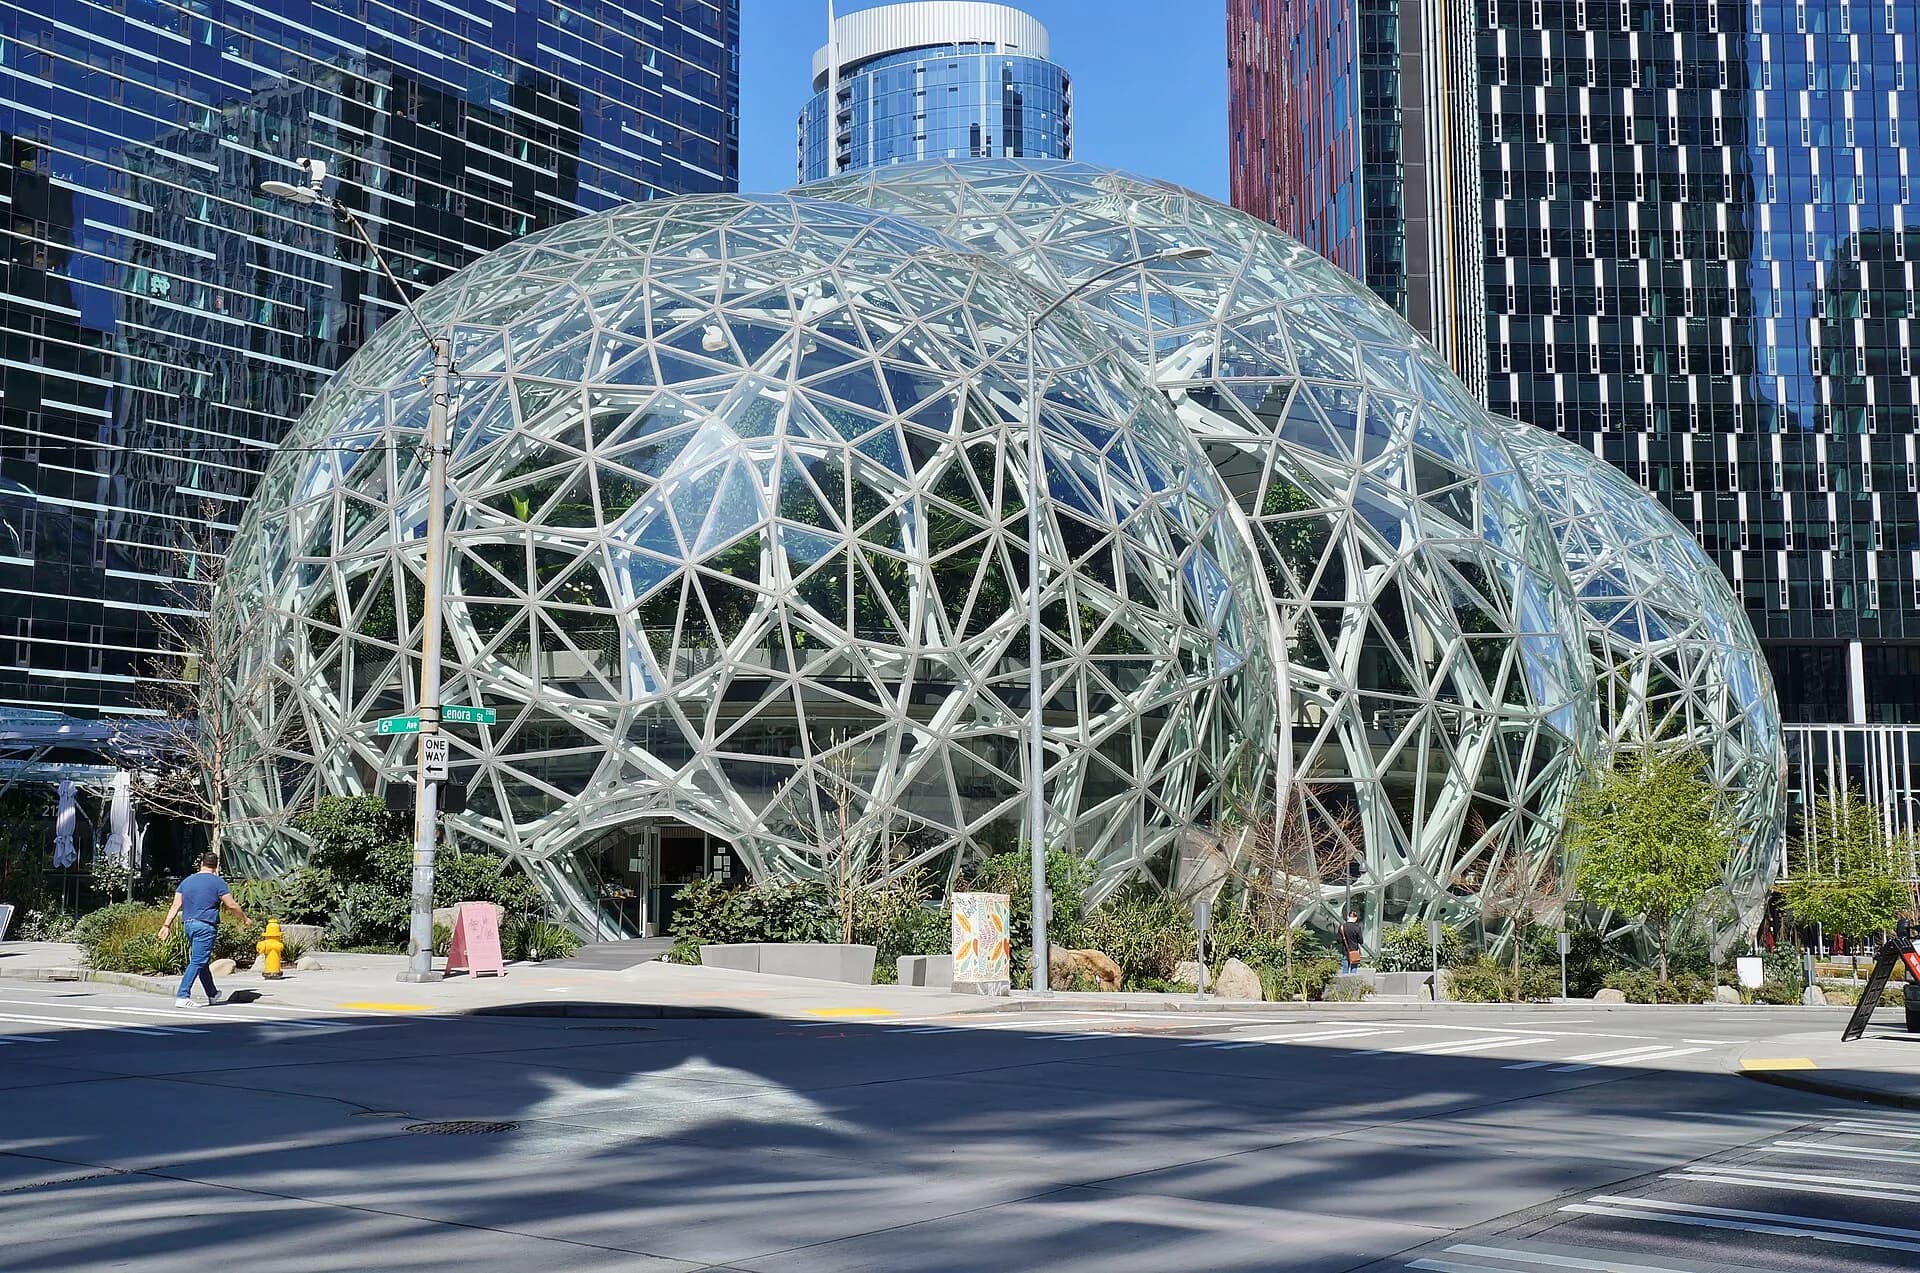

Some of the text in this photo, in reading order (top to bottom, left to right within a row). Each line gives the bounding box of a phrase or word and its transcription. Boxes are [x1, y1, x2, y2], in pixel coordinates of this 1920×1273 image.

[476, 712, 484, 721] St
[406, 720, 418, 730] Ave
[425, 739, 446, 751] ONE
[425, 751, 446, 762] WAY
